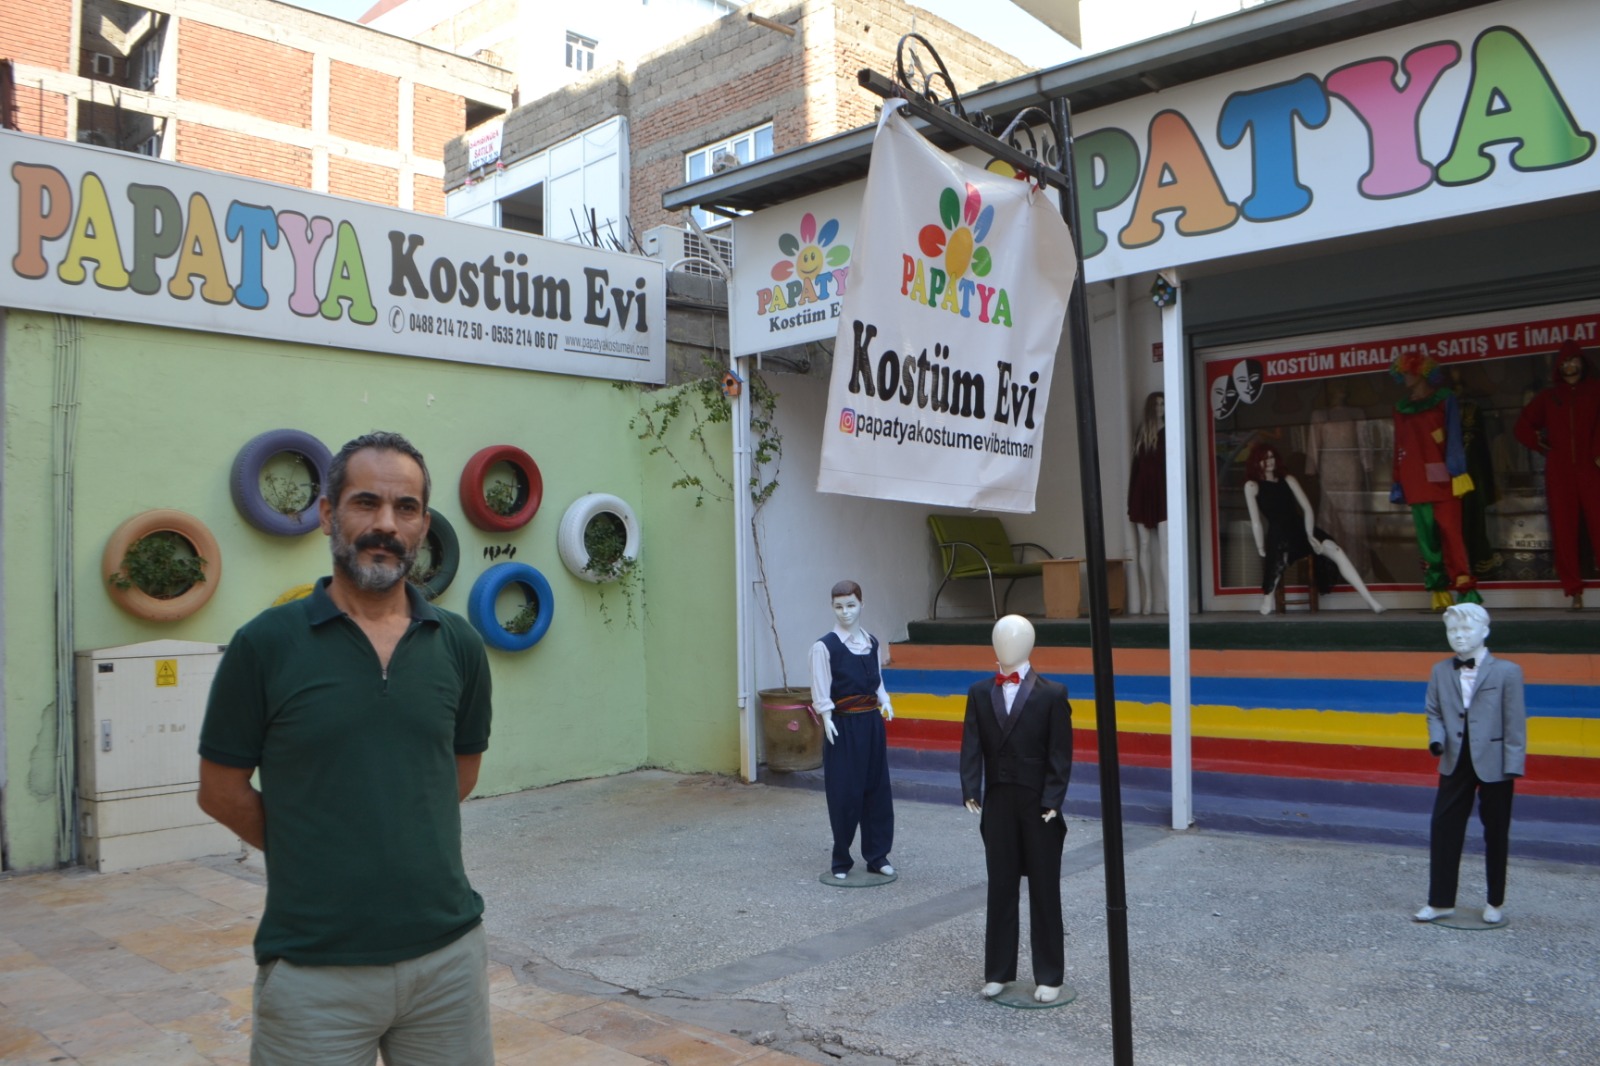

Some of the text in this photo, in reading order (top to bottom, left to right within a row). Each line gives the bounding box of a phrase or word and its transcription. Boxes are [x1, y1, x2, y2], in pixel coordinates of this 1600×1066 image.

[985, 25, 1597, 259] PATYA
[11, 161, 649, 333] PAPATYA Kostüm Evi
[769, 302, 843, 333] Kostüm E
[900, 252, 1013, 328] PAPATYA
[409, 313, 434, 334] 0488
[436, 317, 454, 337] 214
[457, 320, 468, 339] 72
[471, 322, 483, 341] 50
[491, 325, 514, 345] 0535
[516, 328, 532, 347] 214
[534, 330, 545, 349] 06
[547, 332, 558, 350] 07
[1267, 352, 1334, 376] KOSTÜM
[1493, 331, 1518, 350] VE
[1524, 322, 1597, 347] İMALAT
[848, 319, 1040, 430] Kostüm Evi
[855, 408, 1034, 460] papatyakostumevibatman
